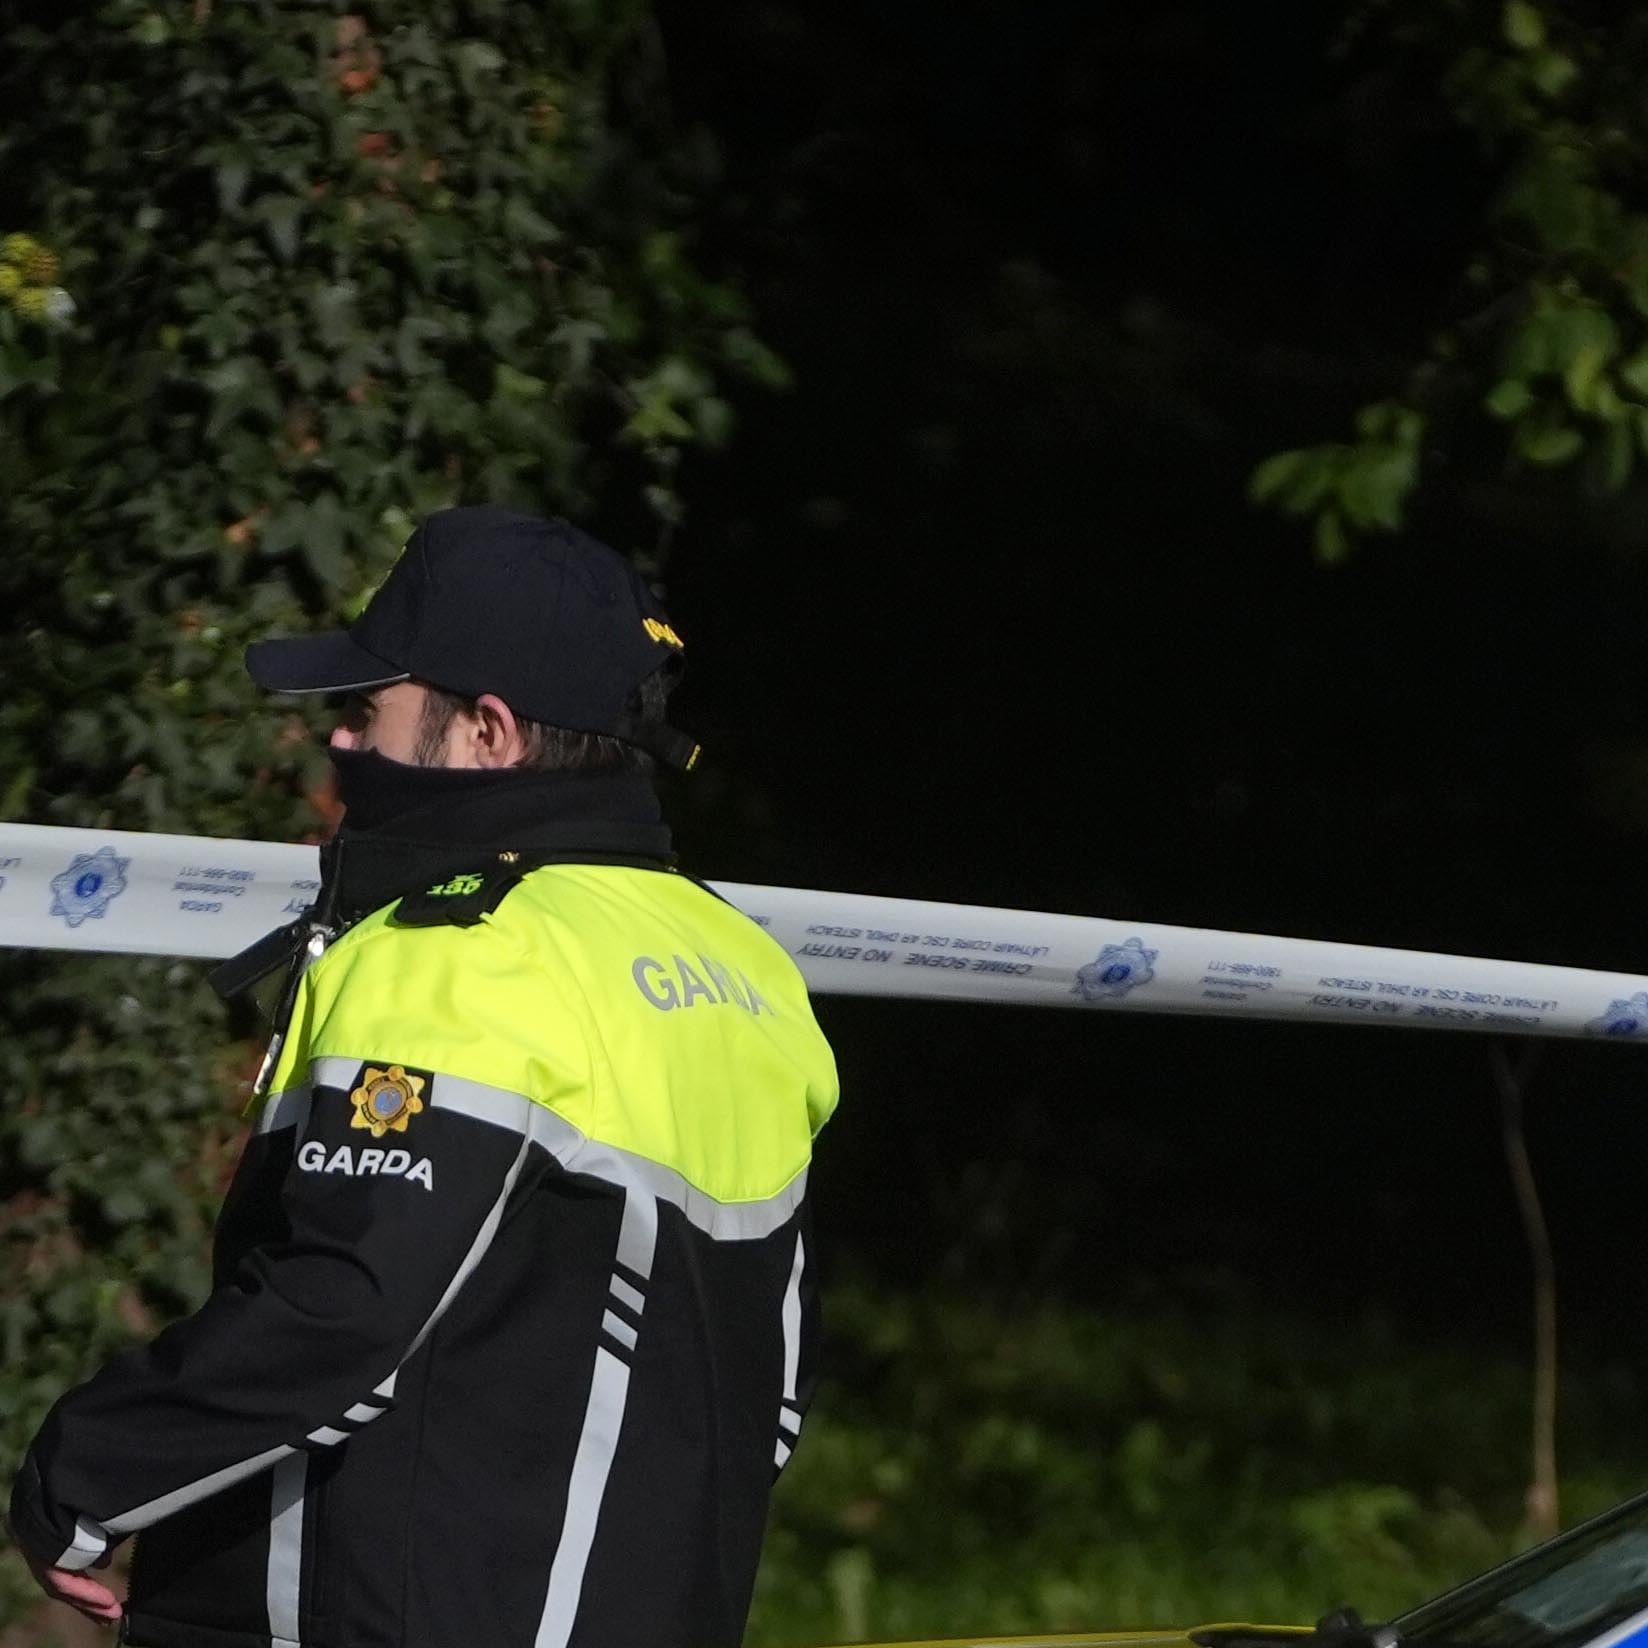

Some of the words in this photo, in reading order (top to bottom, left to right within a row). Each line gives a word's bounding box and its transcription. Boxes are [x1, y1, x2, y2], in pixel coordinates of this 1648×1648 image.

[796, 942, 862, 961] ENTRY
[863, 948, 893, 964] NO
[903, 952, 970, 971] SCENE
[972, 959, 1032, 977] CRIME
[297, 1141, 433, 1191] GARDA
